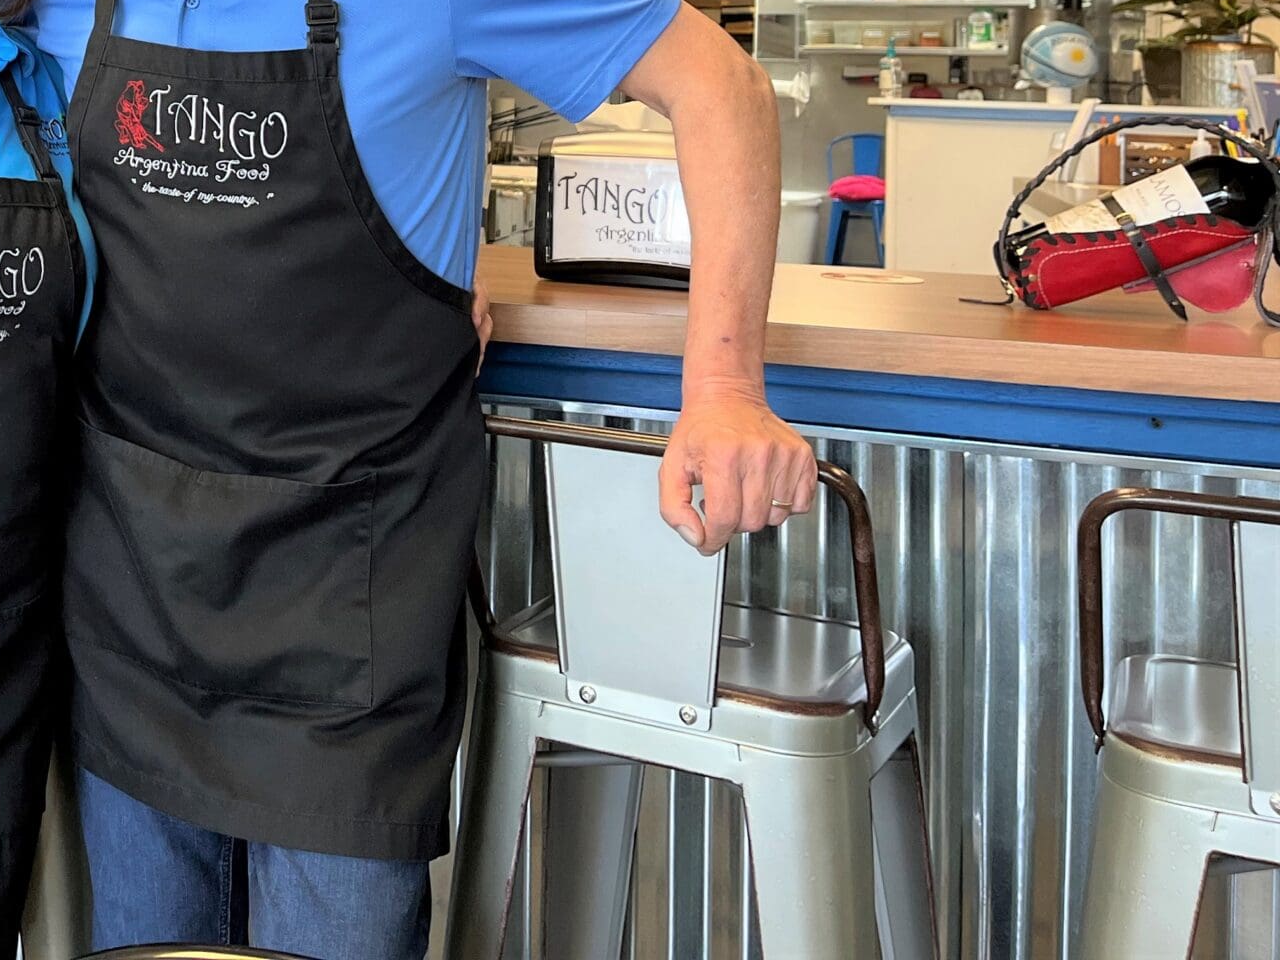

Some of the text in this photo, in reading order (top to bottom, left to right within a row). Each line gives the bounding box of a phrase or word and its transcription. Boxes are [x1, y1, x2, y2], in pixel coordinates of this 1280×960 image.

[149, 85, 288, 160] TANGO
[113, 146, 270, 182] Argentina Food
[183, 188, 199, 202] of
[557, 172, 668, 225] TANGO
